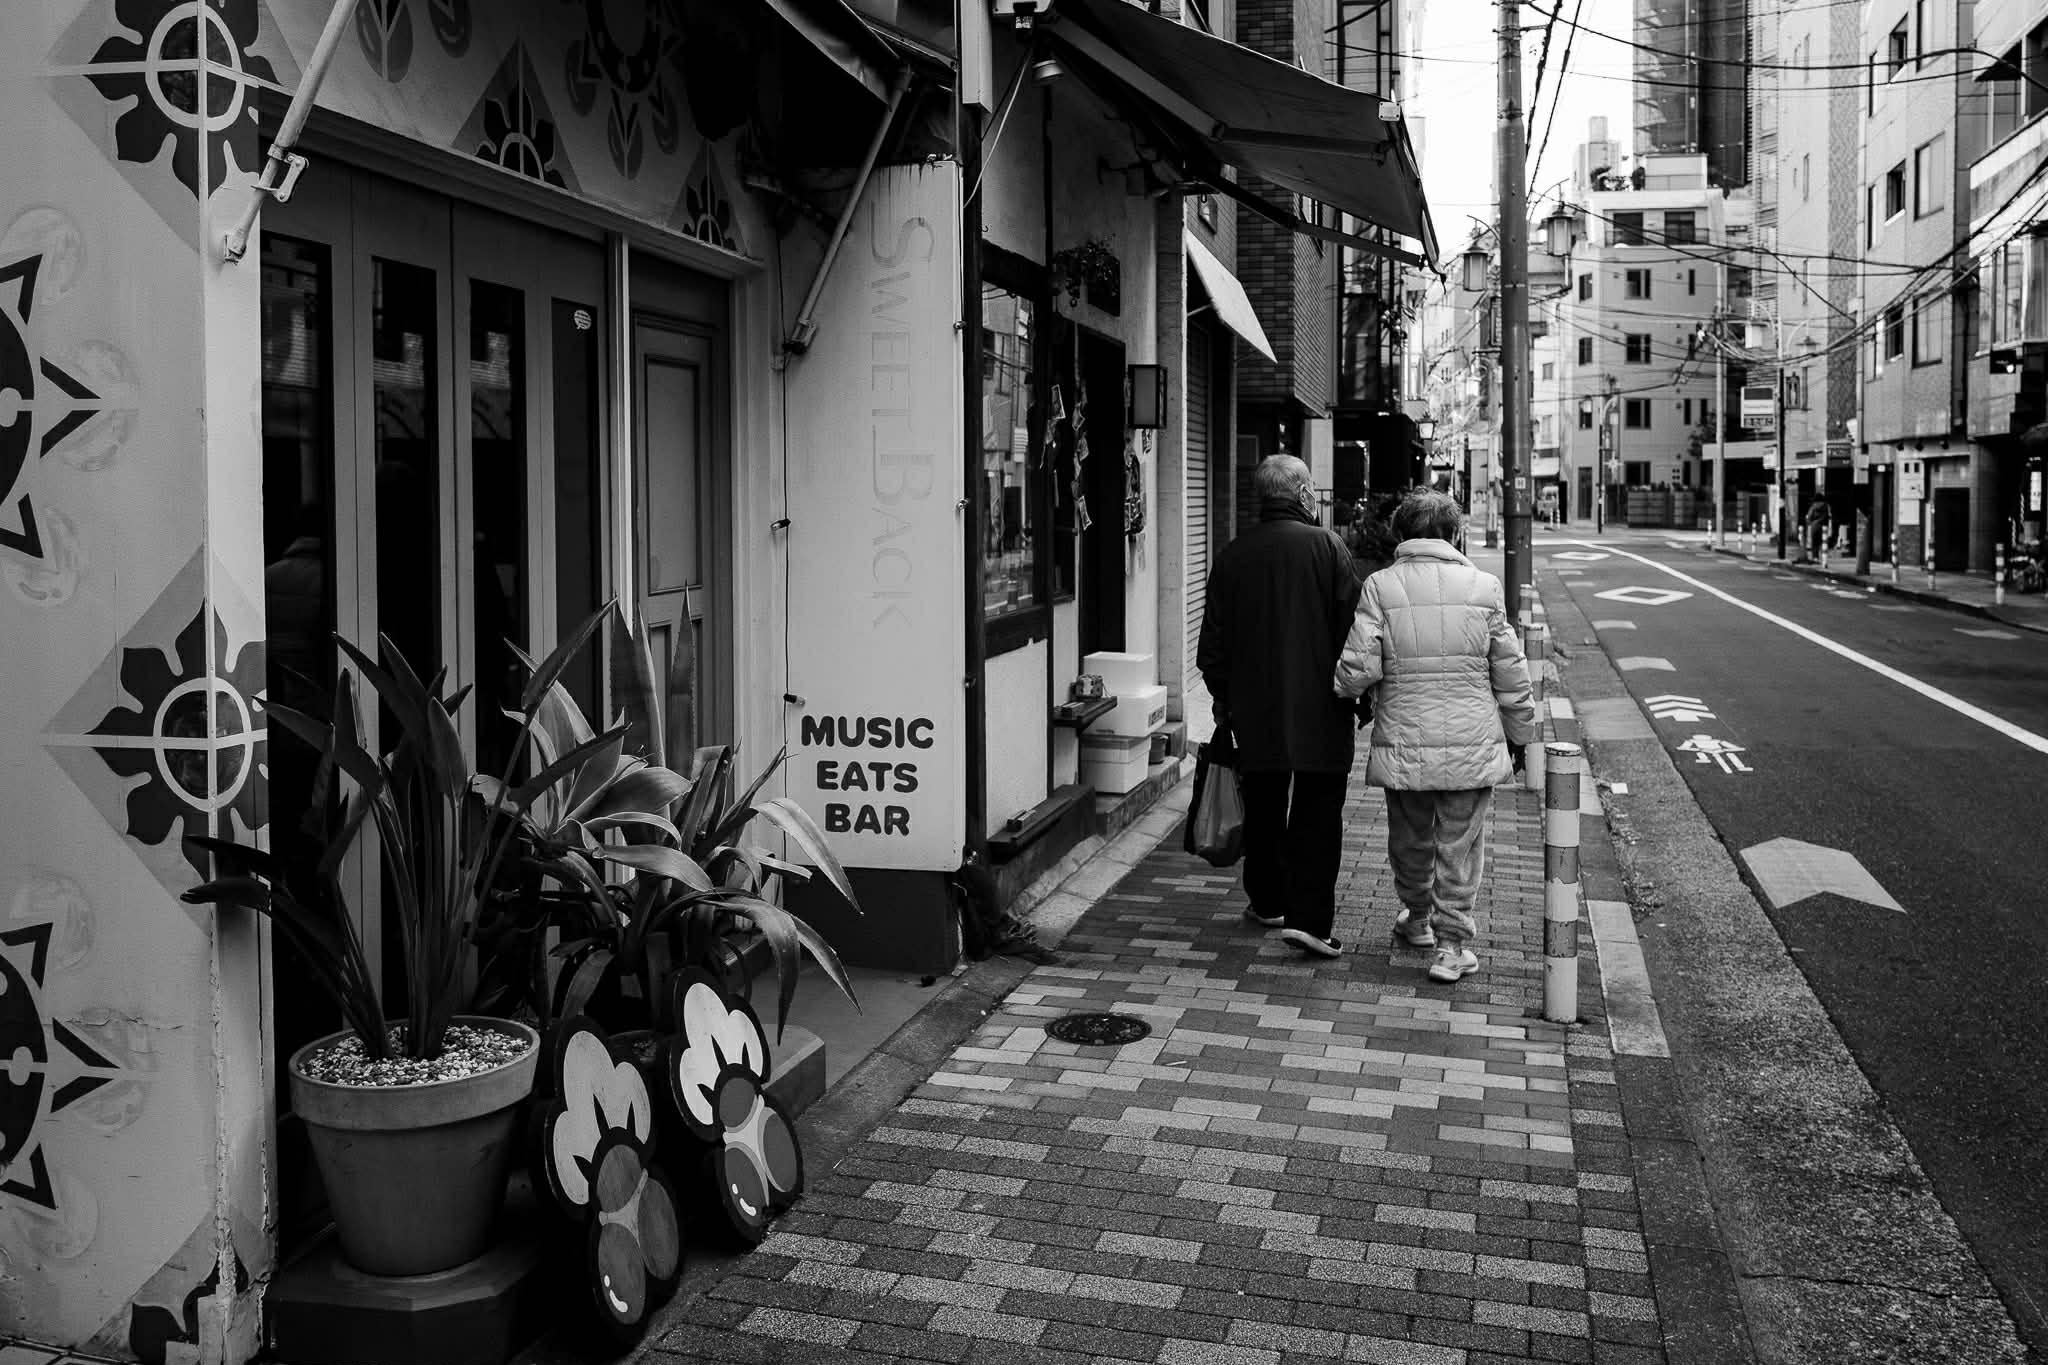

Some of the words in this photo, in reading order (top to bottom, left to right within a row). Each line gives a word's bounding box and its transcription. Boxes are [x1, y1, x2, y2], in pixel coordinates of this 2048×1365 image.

[801, 714, 935, 749] MUSIC
[816, 760, 919, 793] EATS
[824, 802, 910, 836] BAR
